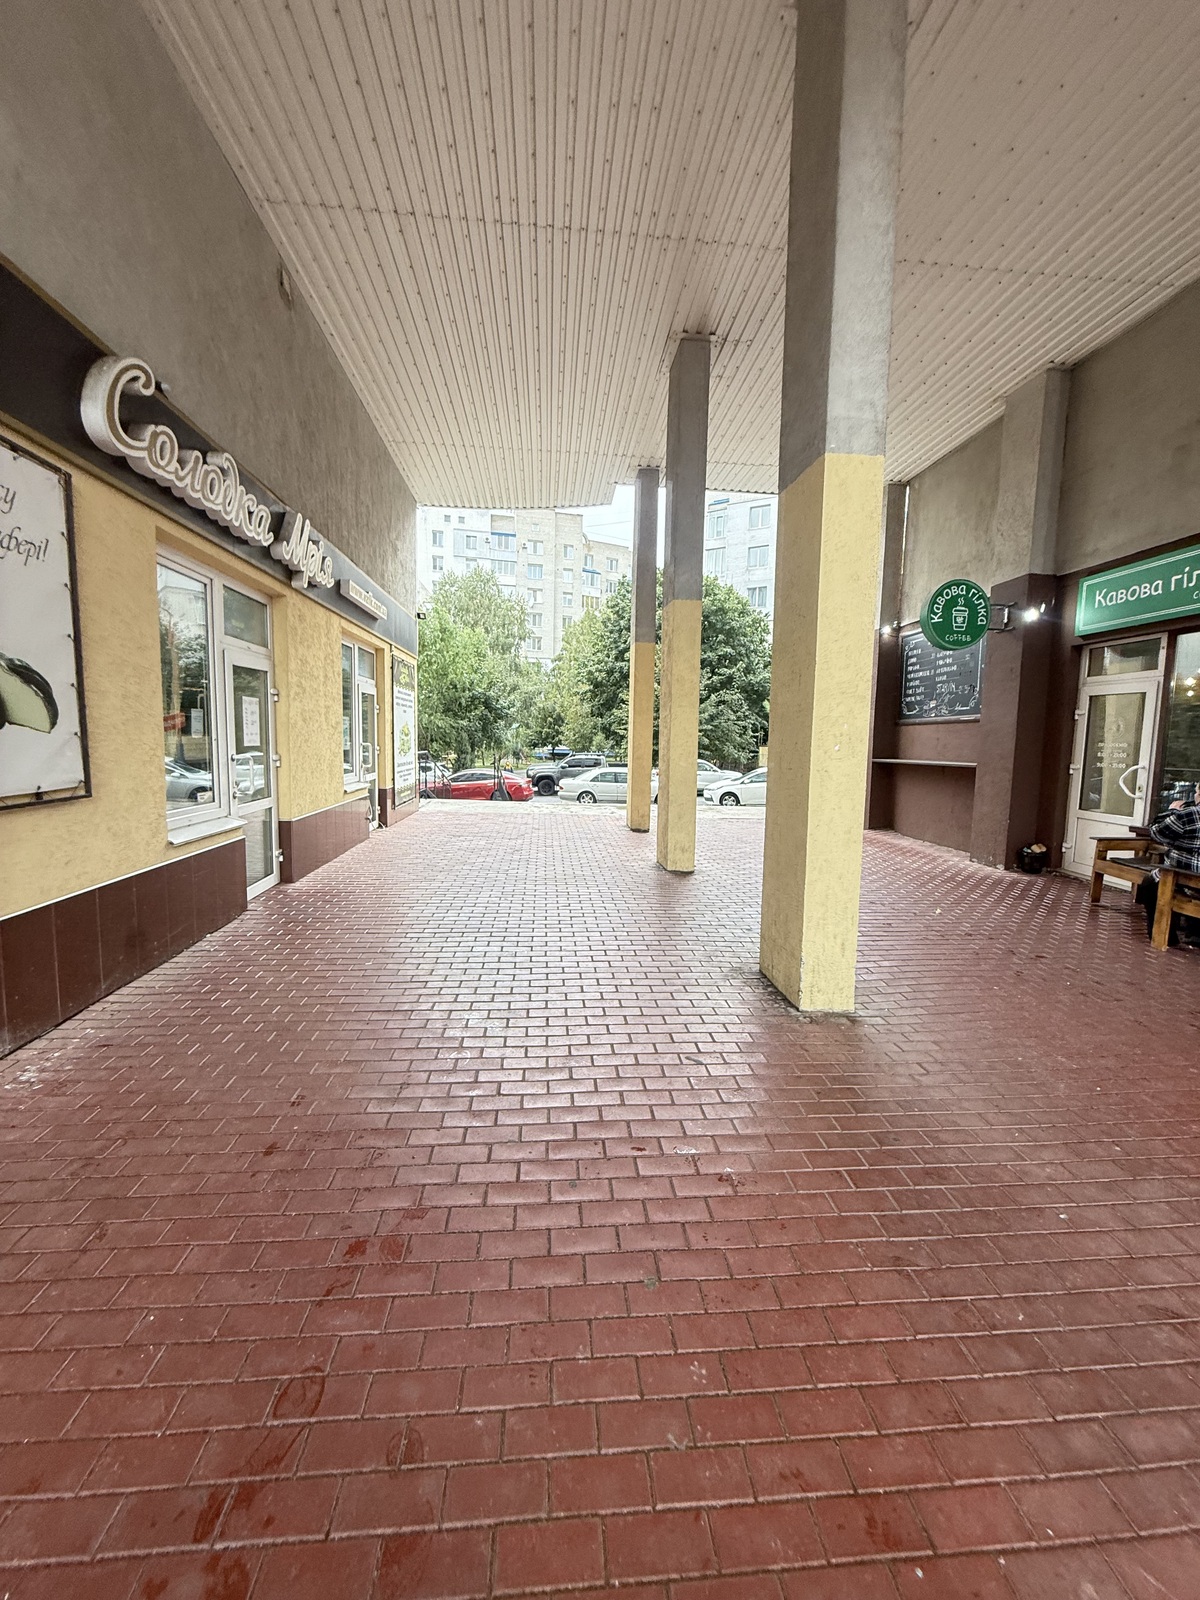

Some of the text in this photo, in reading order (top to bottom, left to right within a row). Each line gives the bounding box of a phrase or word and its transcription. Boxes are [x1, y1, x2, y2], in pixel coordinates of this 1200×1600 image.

[81, 356, 335, 588] Солодка Мрія
[0, 526, 49, 566] фері!
[930, 584, 987, 625] Кавова гілка
[1094, 579, 1163, 609] Кавова
[945, 633, 971, 642] COFFEE
